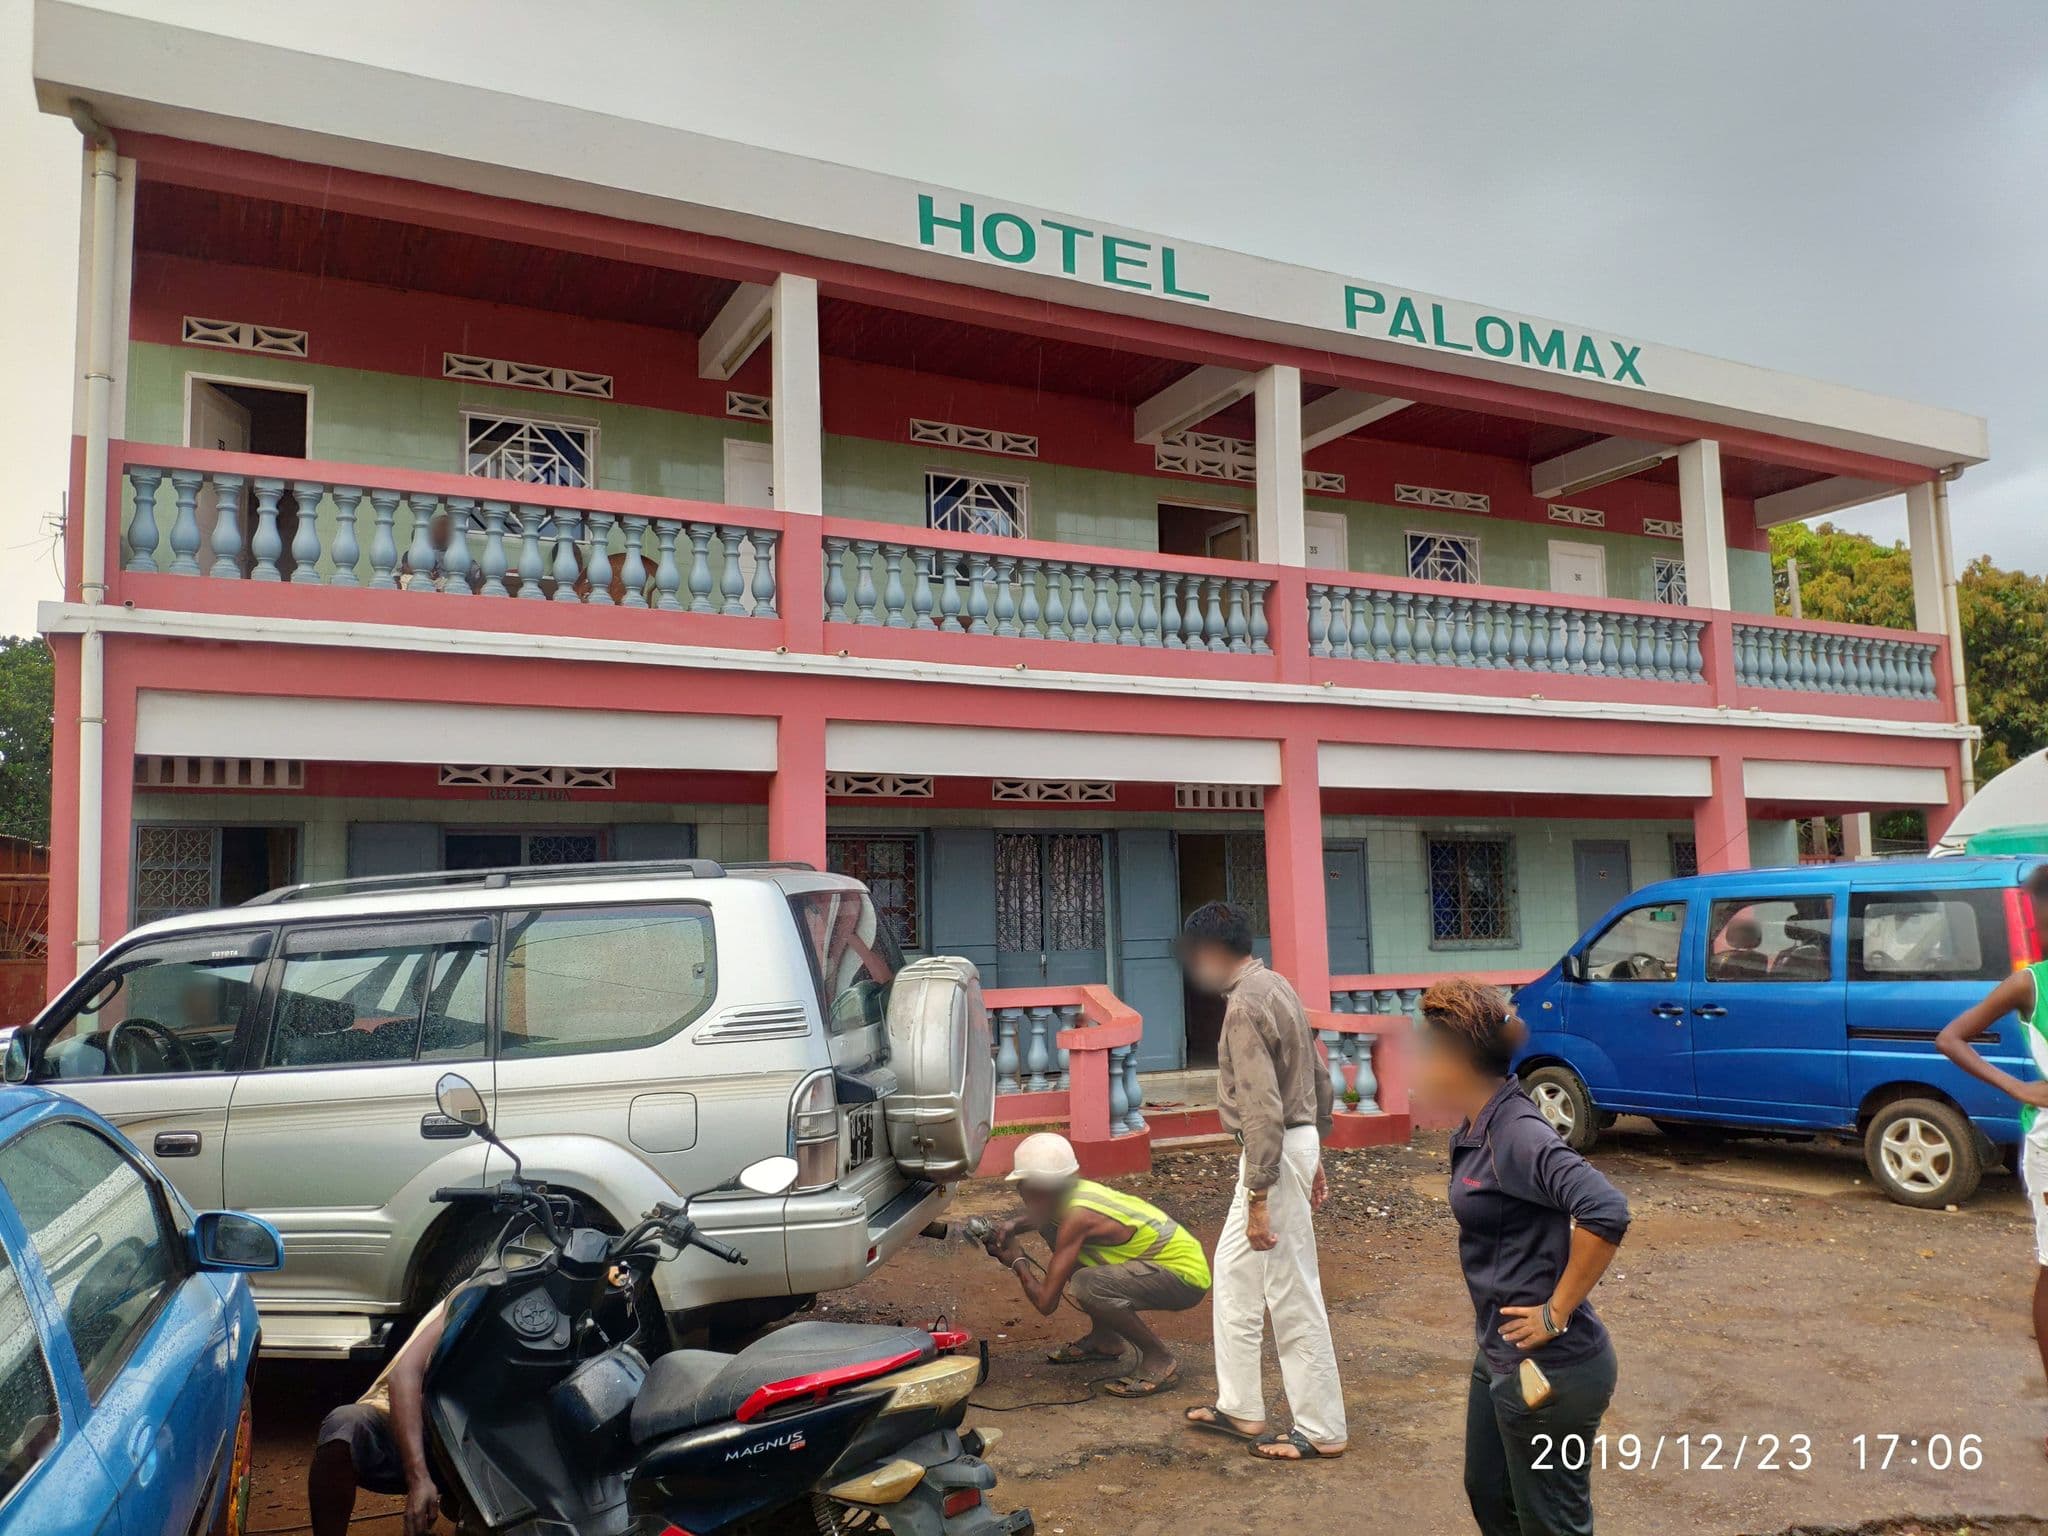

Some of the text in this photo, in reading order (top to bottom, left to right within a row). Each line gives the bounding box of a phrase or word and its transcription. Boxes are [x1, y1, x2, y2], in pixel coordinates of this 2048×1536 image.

[918, 193, 1647, 387] HOTEL PALOMAX
[725, 1430, 803, 1461] MAGNUS
